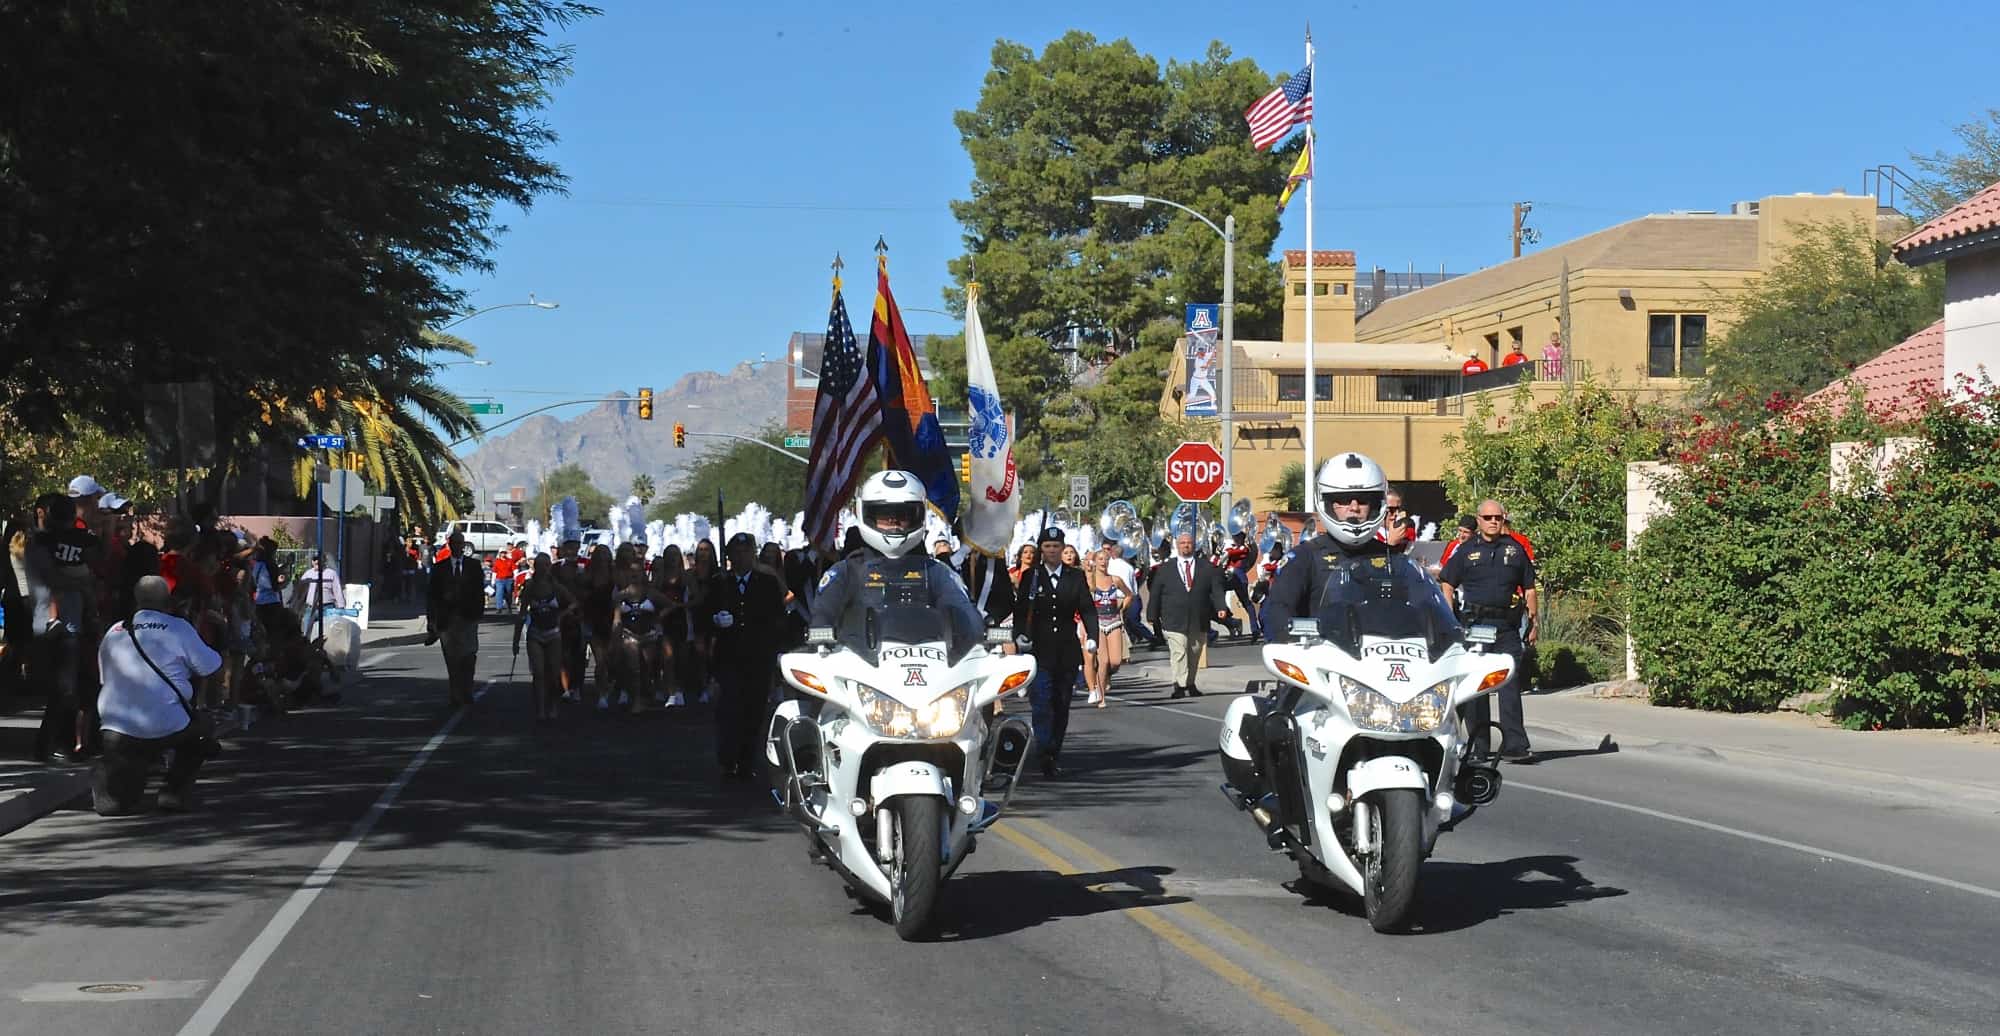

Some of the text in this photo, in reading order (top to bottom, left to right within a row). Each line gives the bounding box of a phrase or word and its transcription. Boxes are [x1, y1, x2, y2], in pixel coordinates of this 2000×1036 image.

[1191, 309, 1212, 328] A
[331, 437, 342, 446] ST
[1170, 460, 1221, 483] STOP
[1073, 494, 1087, 507] 20
[882, 648, 945, 661] POLICE
[1364, 645, 1426, 659] POLICE
[904, 668, 927, 686] A
[1387, 663, 1411, 682] A
